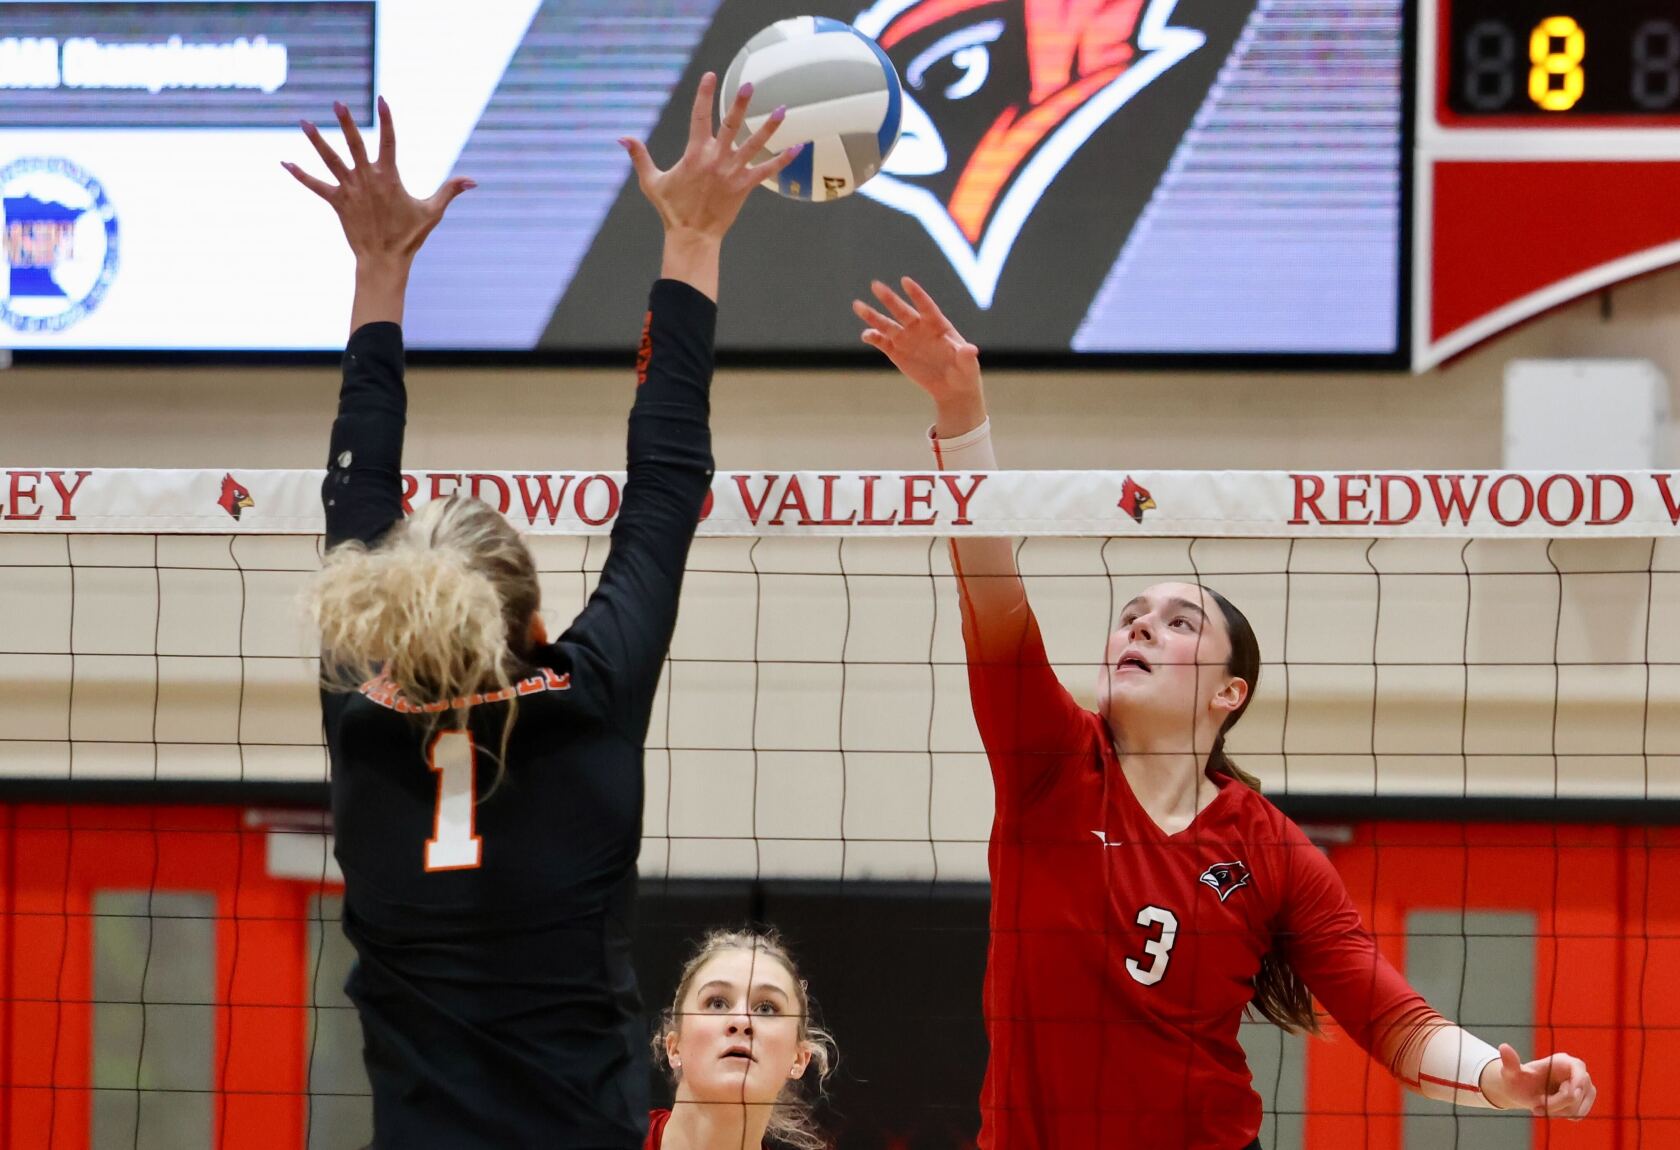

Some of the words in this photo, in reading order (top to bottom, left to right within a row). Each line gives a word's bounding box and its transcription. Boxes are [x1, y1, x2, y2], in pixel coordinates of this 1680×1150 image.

[1528, 15, 1585, 111] 8
[0, 471, 92, 521] EY
[731, 474, 988, 526] VALLEY
[1287, 473, 1634, 527] REDWOOD
[424, 729, 482, 872] 1
[1125, 905, 1179, 986] 3
